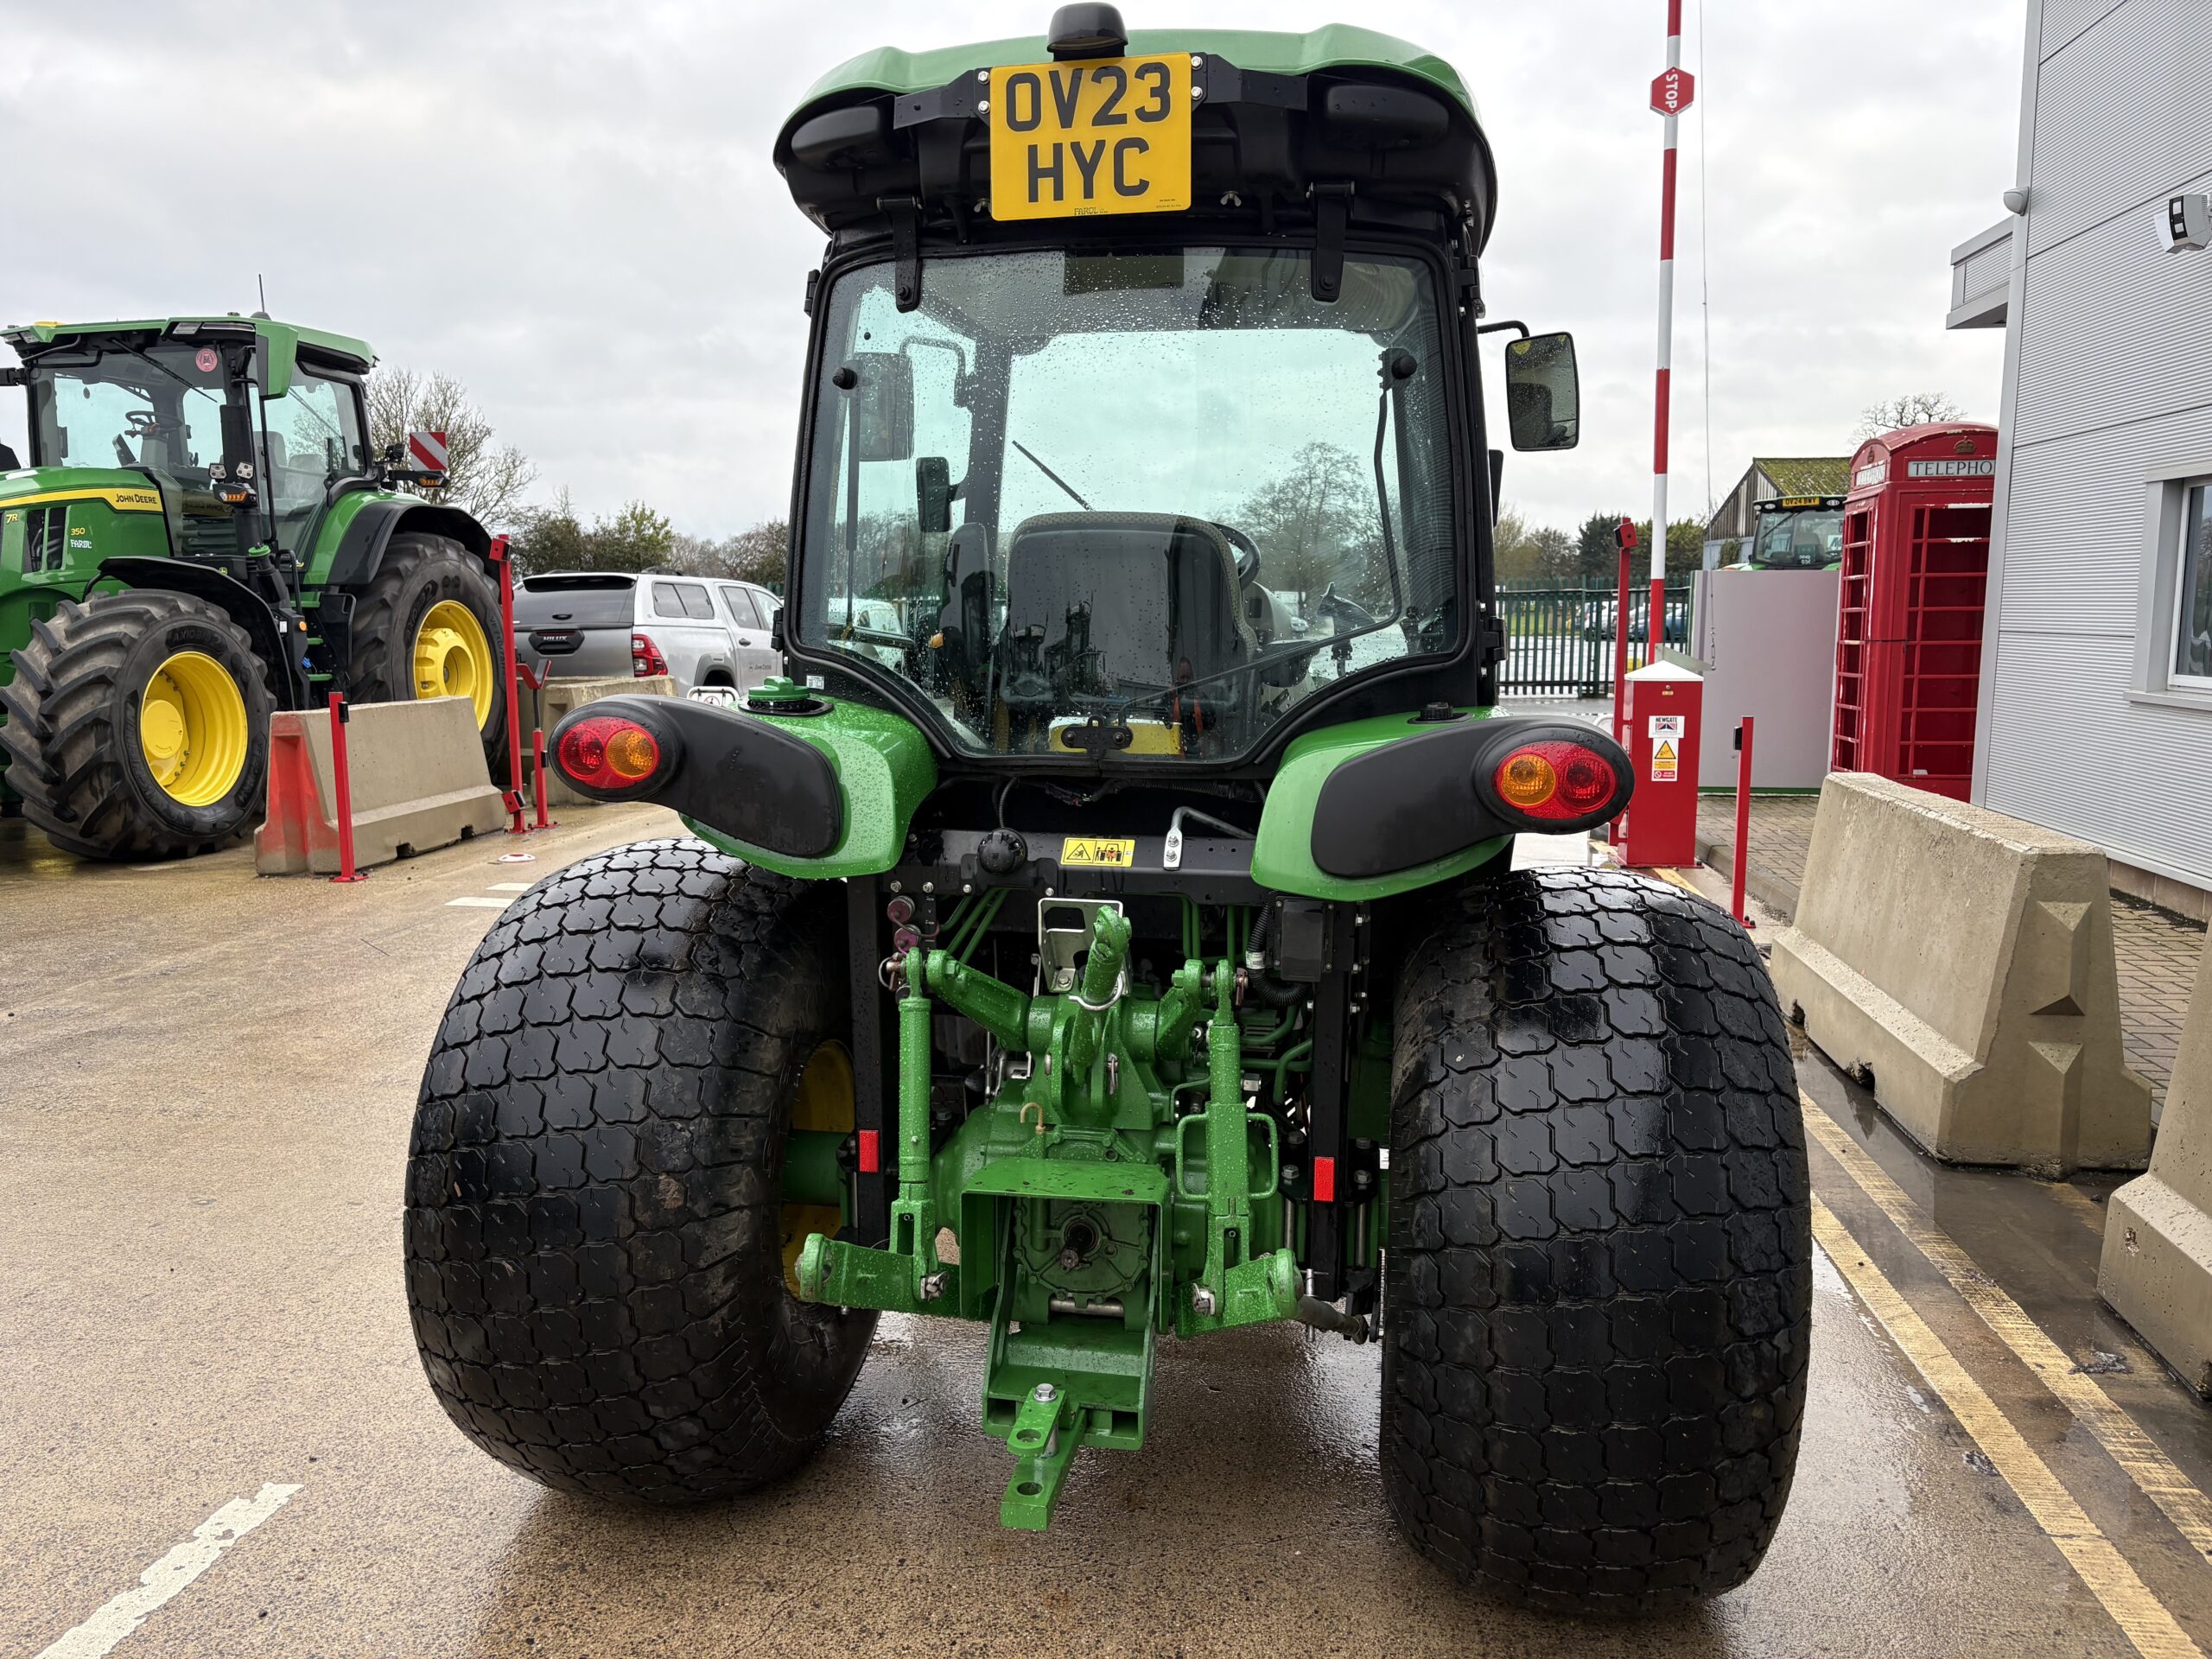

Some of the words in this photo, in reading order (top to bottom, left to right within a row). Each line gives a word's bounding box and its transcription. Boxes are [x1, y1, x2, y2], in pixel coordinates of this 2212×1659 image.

[1006, 61, 1172, 132] OV23
[1665, 73, 1679, 109] STOP
[1027, 137, 1151, 203] HYC
[1074, 207, 1099, 216] FAROL
[1913, 461, 1996, 476] TELEPHO
[116, 493, 134, 503] JOHN
[135, 493, 157, 505] DEERE
[6, 513, 19, 524] 7R
[71, 527, 86, 536] 350
